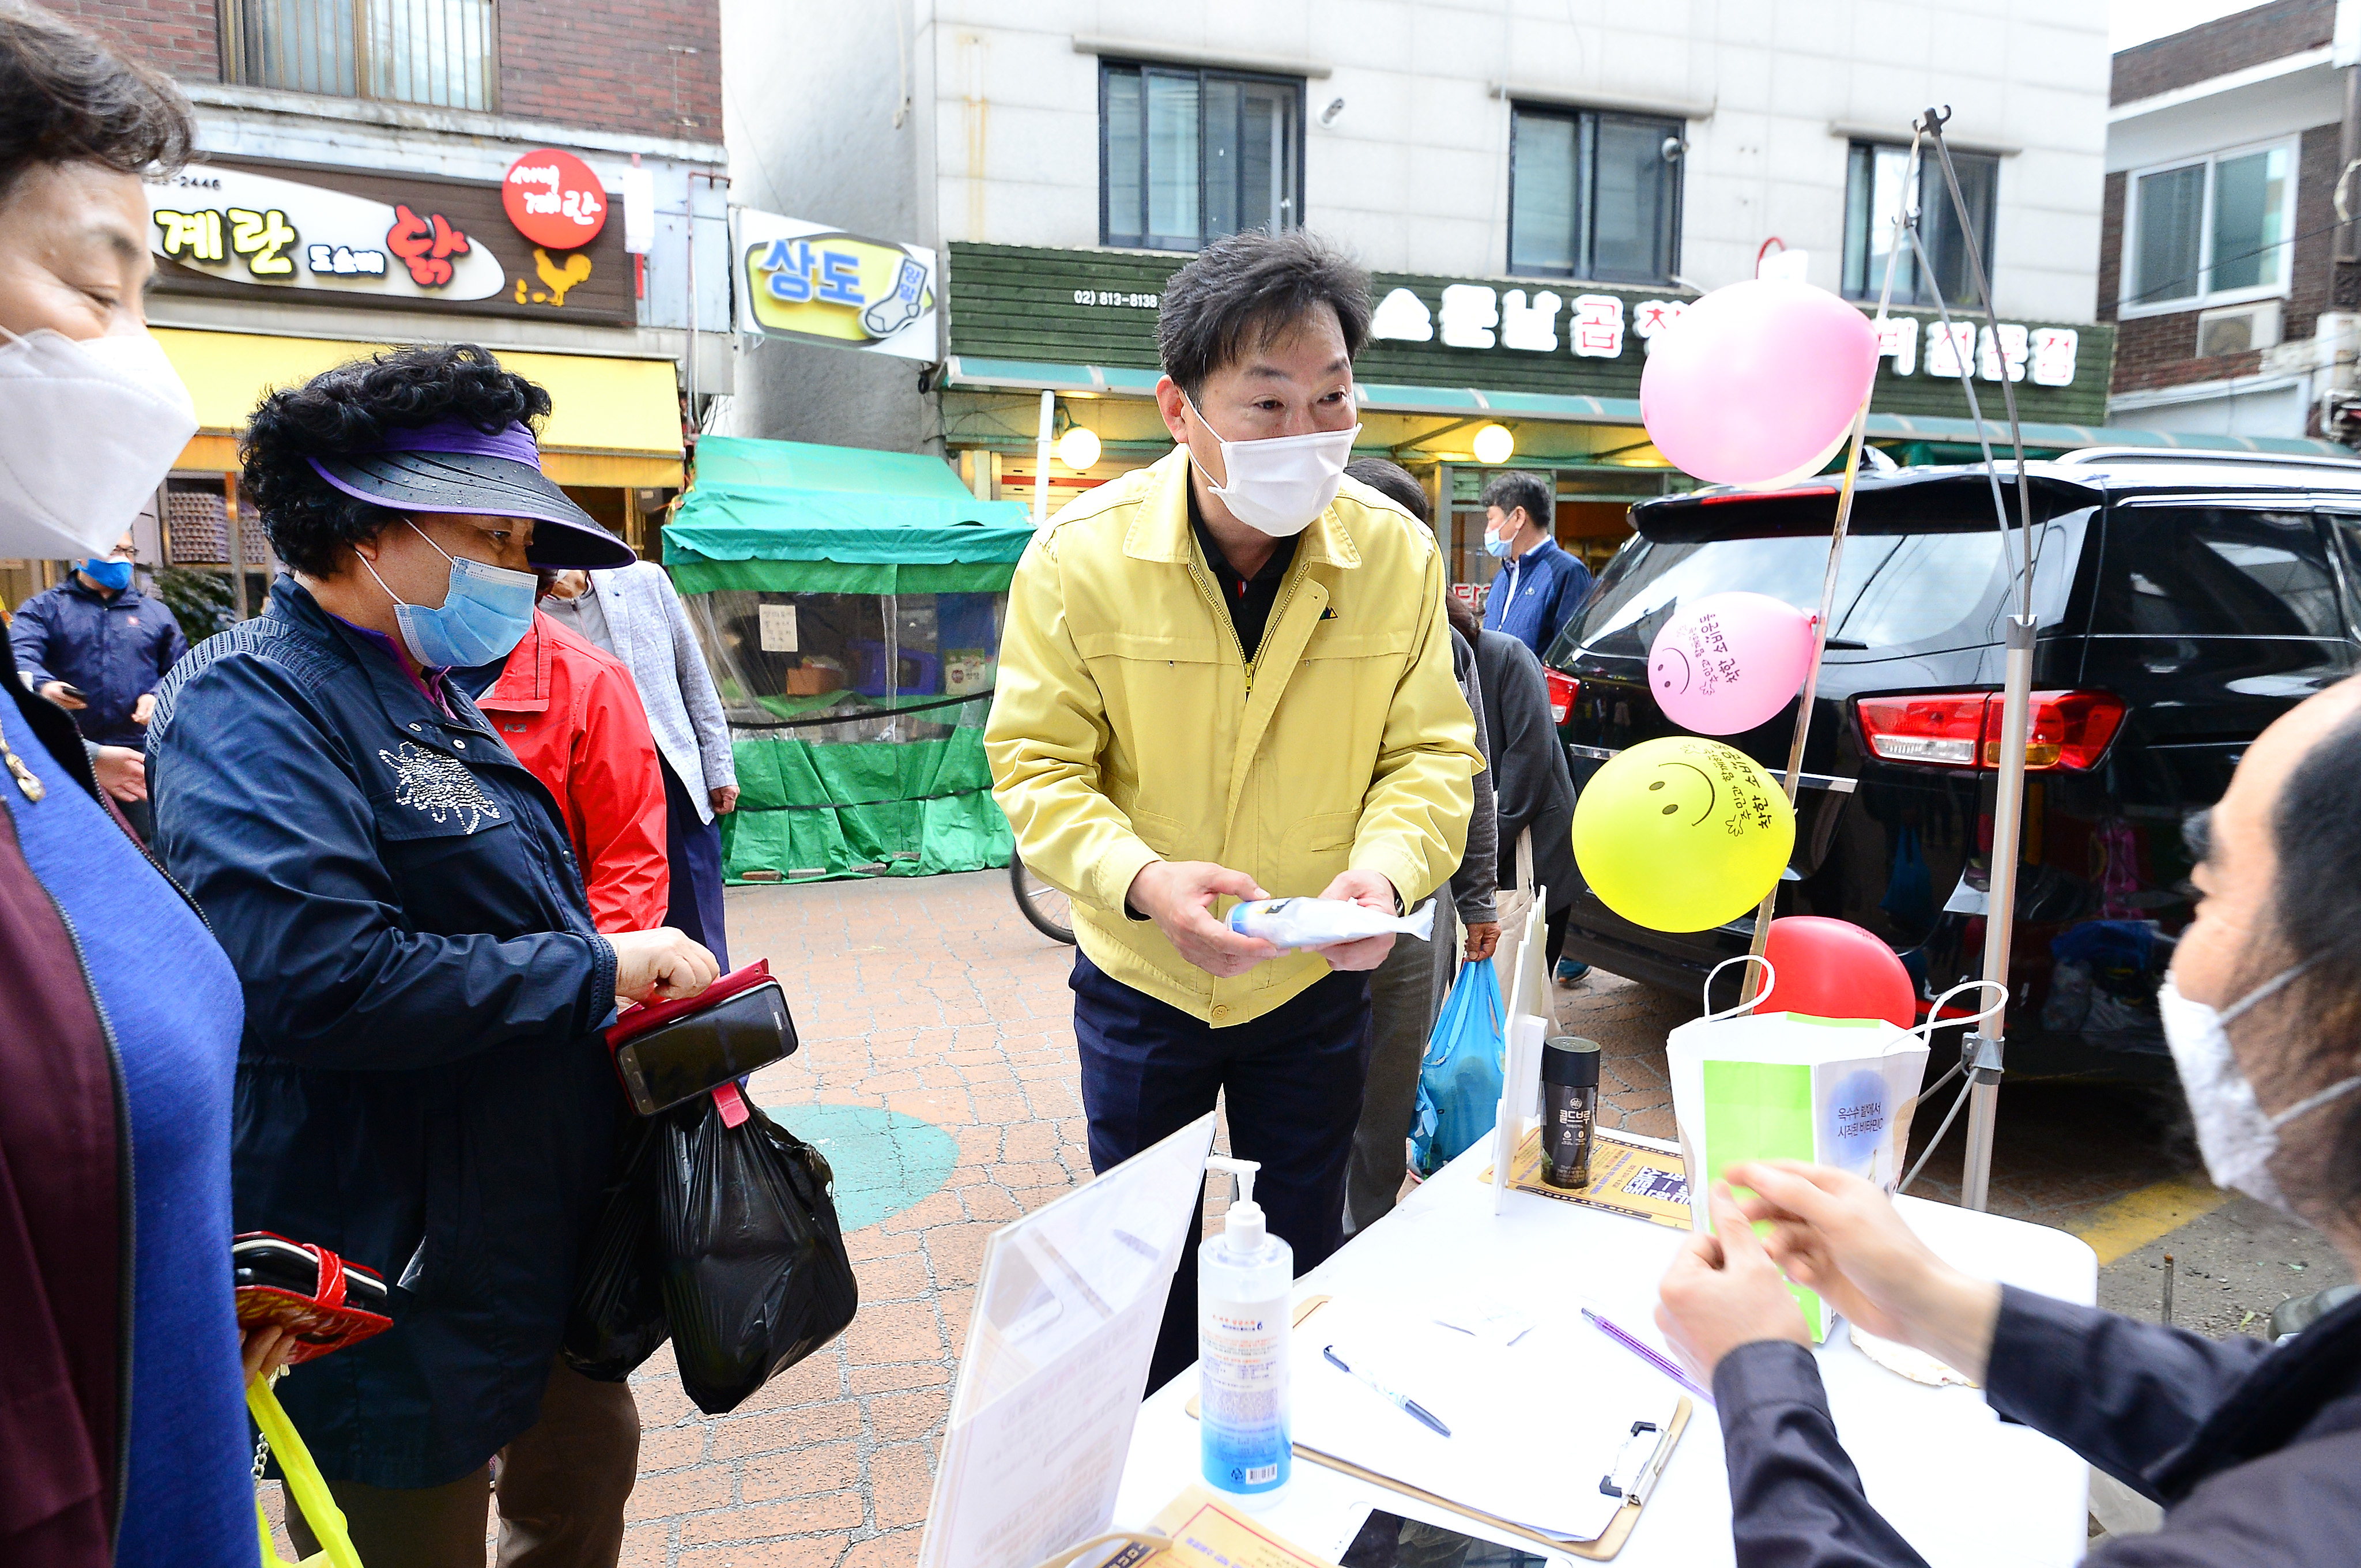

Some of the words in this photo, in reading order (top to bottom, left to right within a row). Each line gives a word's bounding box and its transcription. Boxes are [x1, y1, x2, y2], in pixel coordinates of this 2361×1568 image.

[154, 208, 296, 275] 계란
[309, 244, 385, 274] 도소매
[387, 204, 470, 285] 닭
[764, 239, 865, 304] 상도
[900, 265, 921, 301] 양말
[1074, 290, 1096, 306] 02)
[1099, 292, 1157, 308] 813-8138
[1700, 614, 1728, 652] 소비운동
[1702, 659, 1719, 683] 주민과
[1718, 658, 1740, 683] 착한
[1703, 749, 1734, 782] 함께하는
[1732, 785, 1752, 820] 주민과
[1752, 795, 1772, 829] 착한
[1559, 1109, 1590, 1124] 콜드브루
[1838, 1107, 1860, 1121] 옥수수
[1861, 1102, 1881, 1117] 밭에서
[1838, 1123, 1858, 1139] 시작된
[1860, 1118, 1883, 1133] 비타민C
